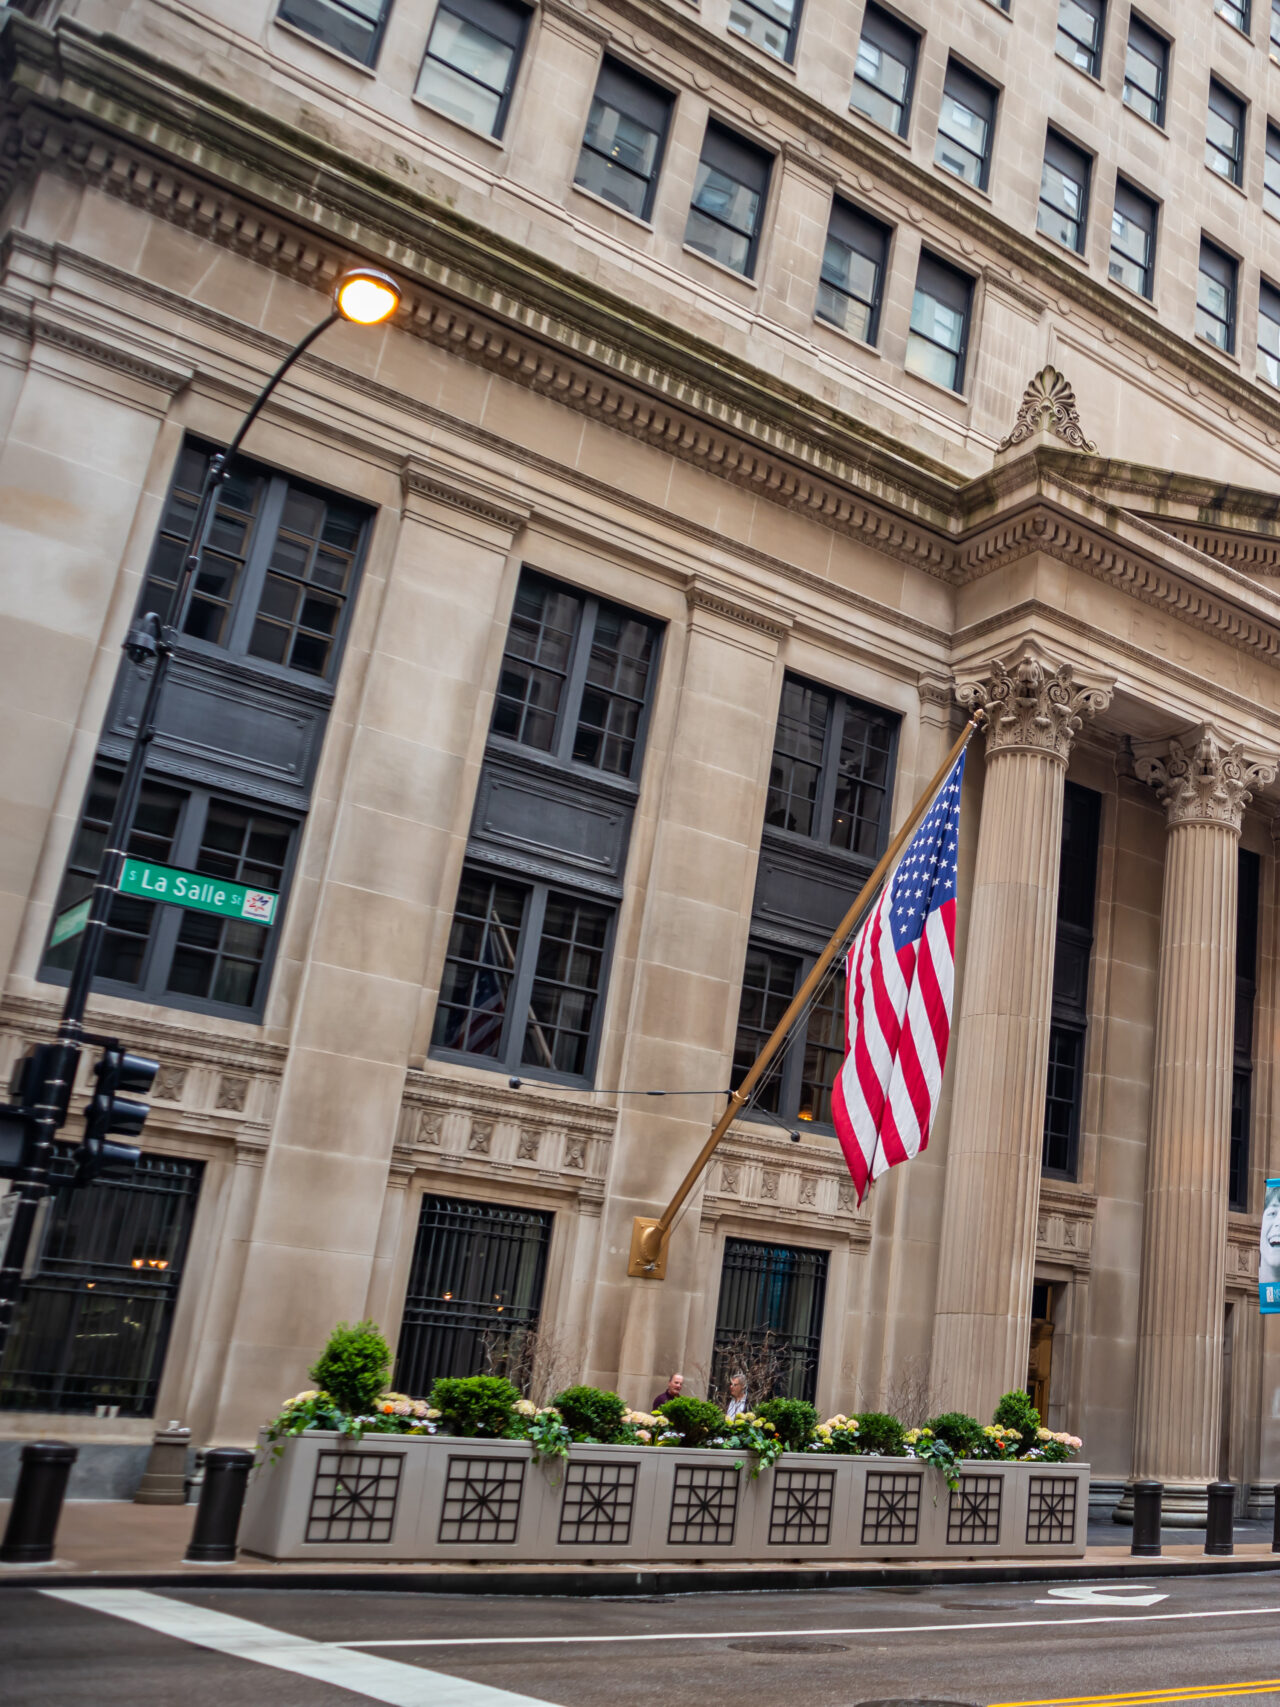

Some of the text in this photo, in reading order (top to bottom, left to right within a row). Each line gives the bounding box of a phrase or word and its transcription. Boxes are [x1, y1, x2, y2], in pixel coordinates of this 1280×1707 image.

[128, 868, 241, 906] S La Salle St
